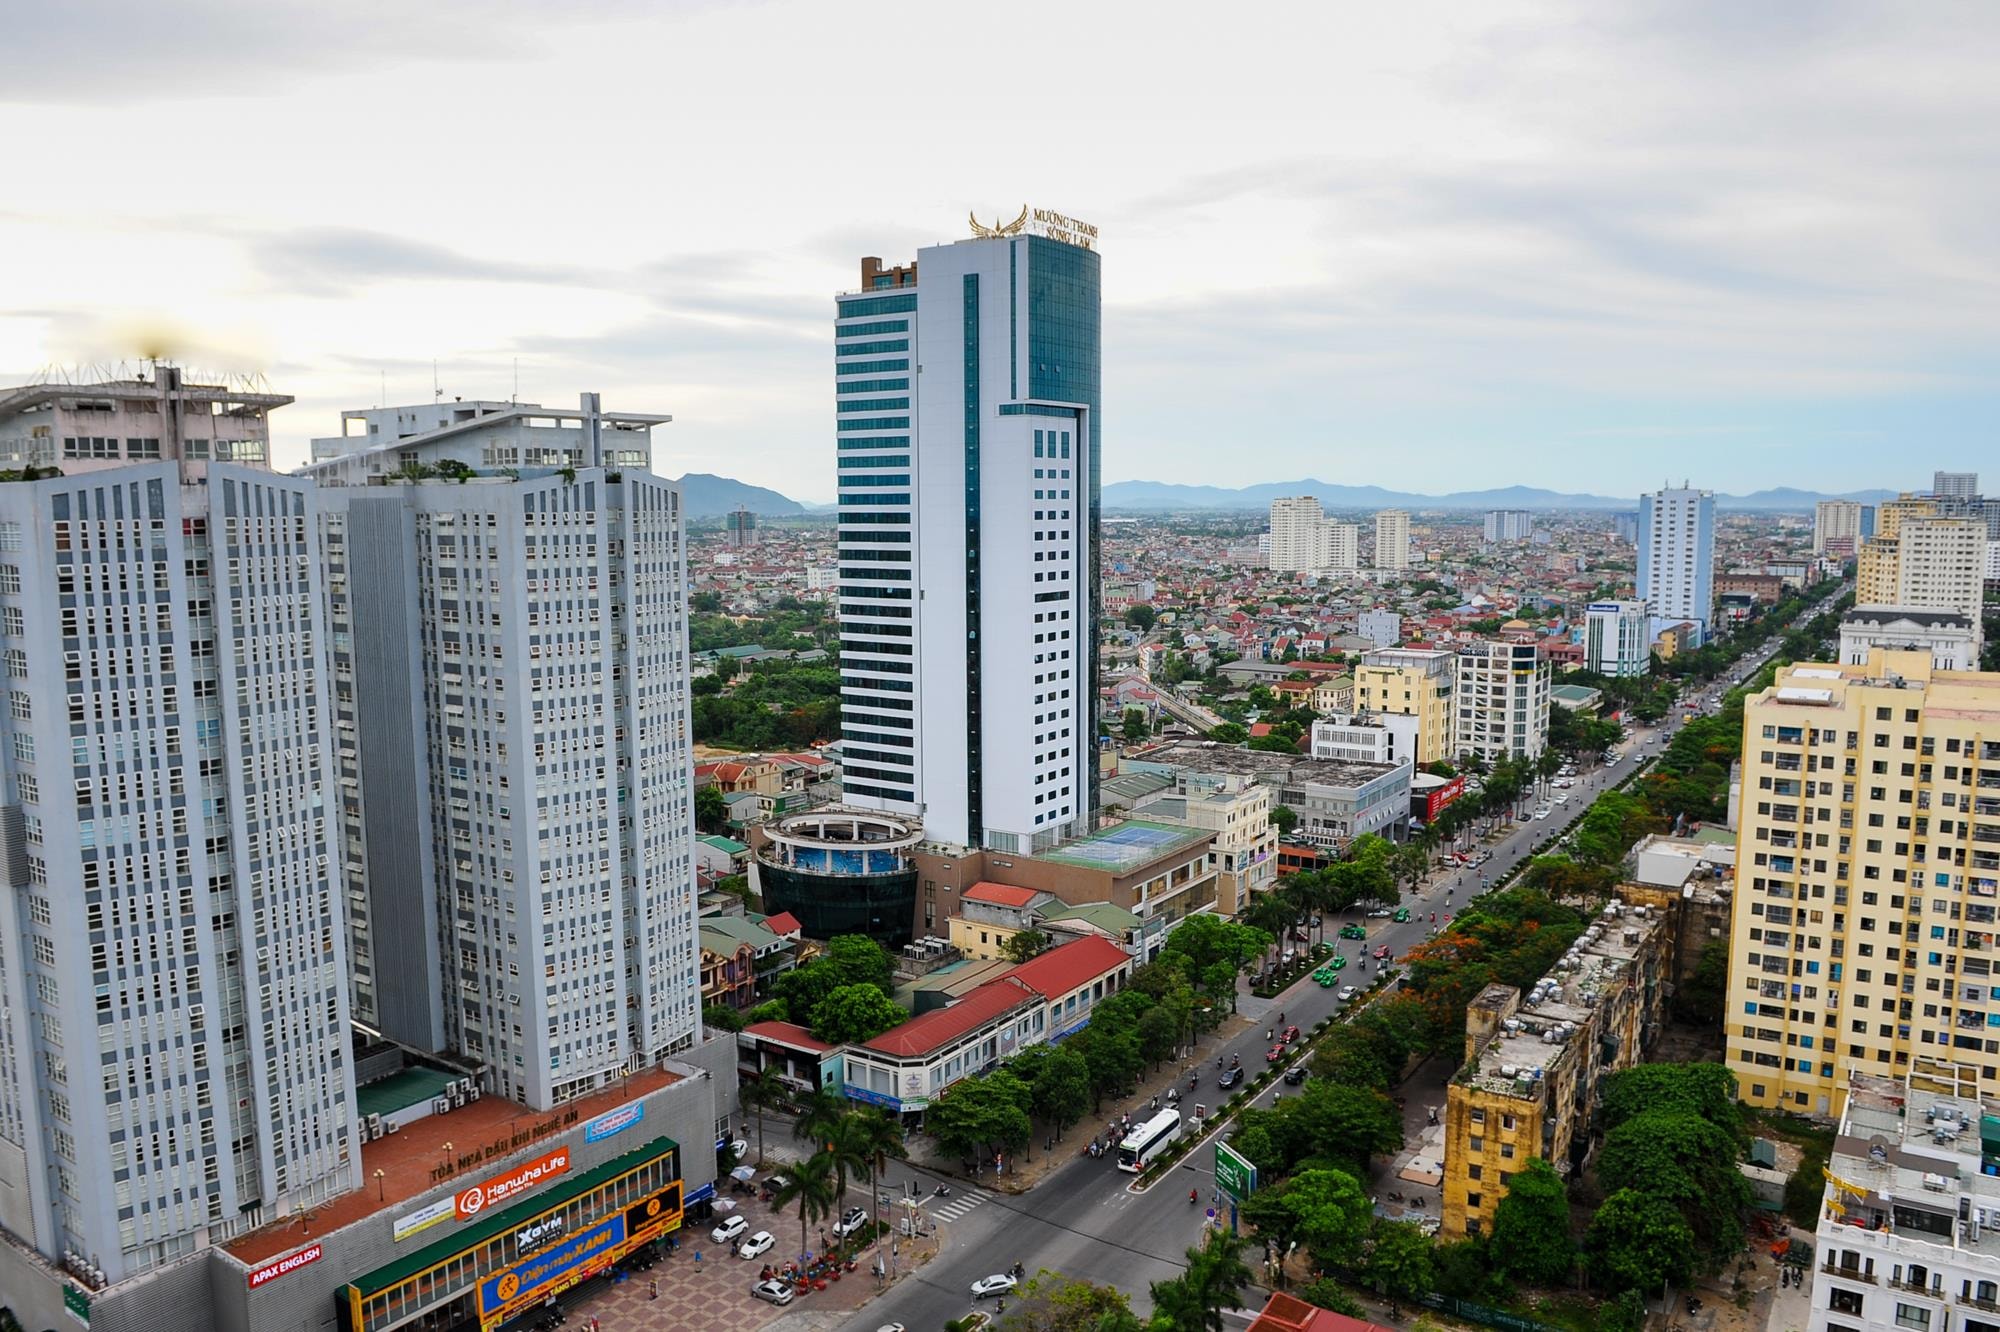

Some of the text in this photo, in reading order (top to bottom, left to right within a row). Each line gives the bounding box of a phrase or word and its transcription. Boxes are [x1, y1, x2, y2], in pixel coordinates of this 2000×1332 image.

[1034, 208, 1098, 239] MƯỜNG THANH
[487, 1156, 566, 1199] Hanwha Life
[518, 1217, 562, 1247] XGYM
[253, 1247, 320, 1285] APAX ENGLISH
